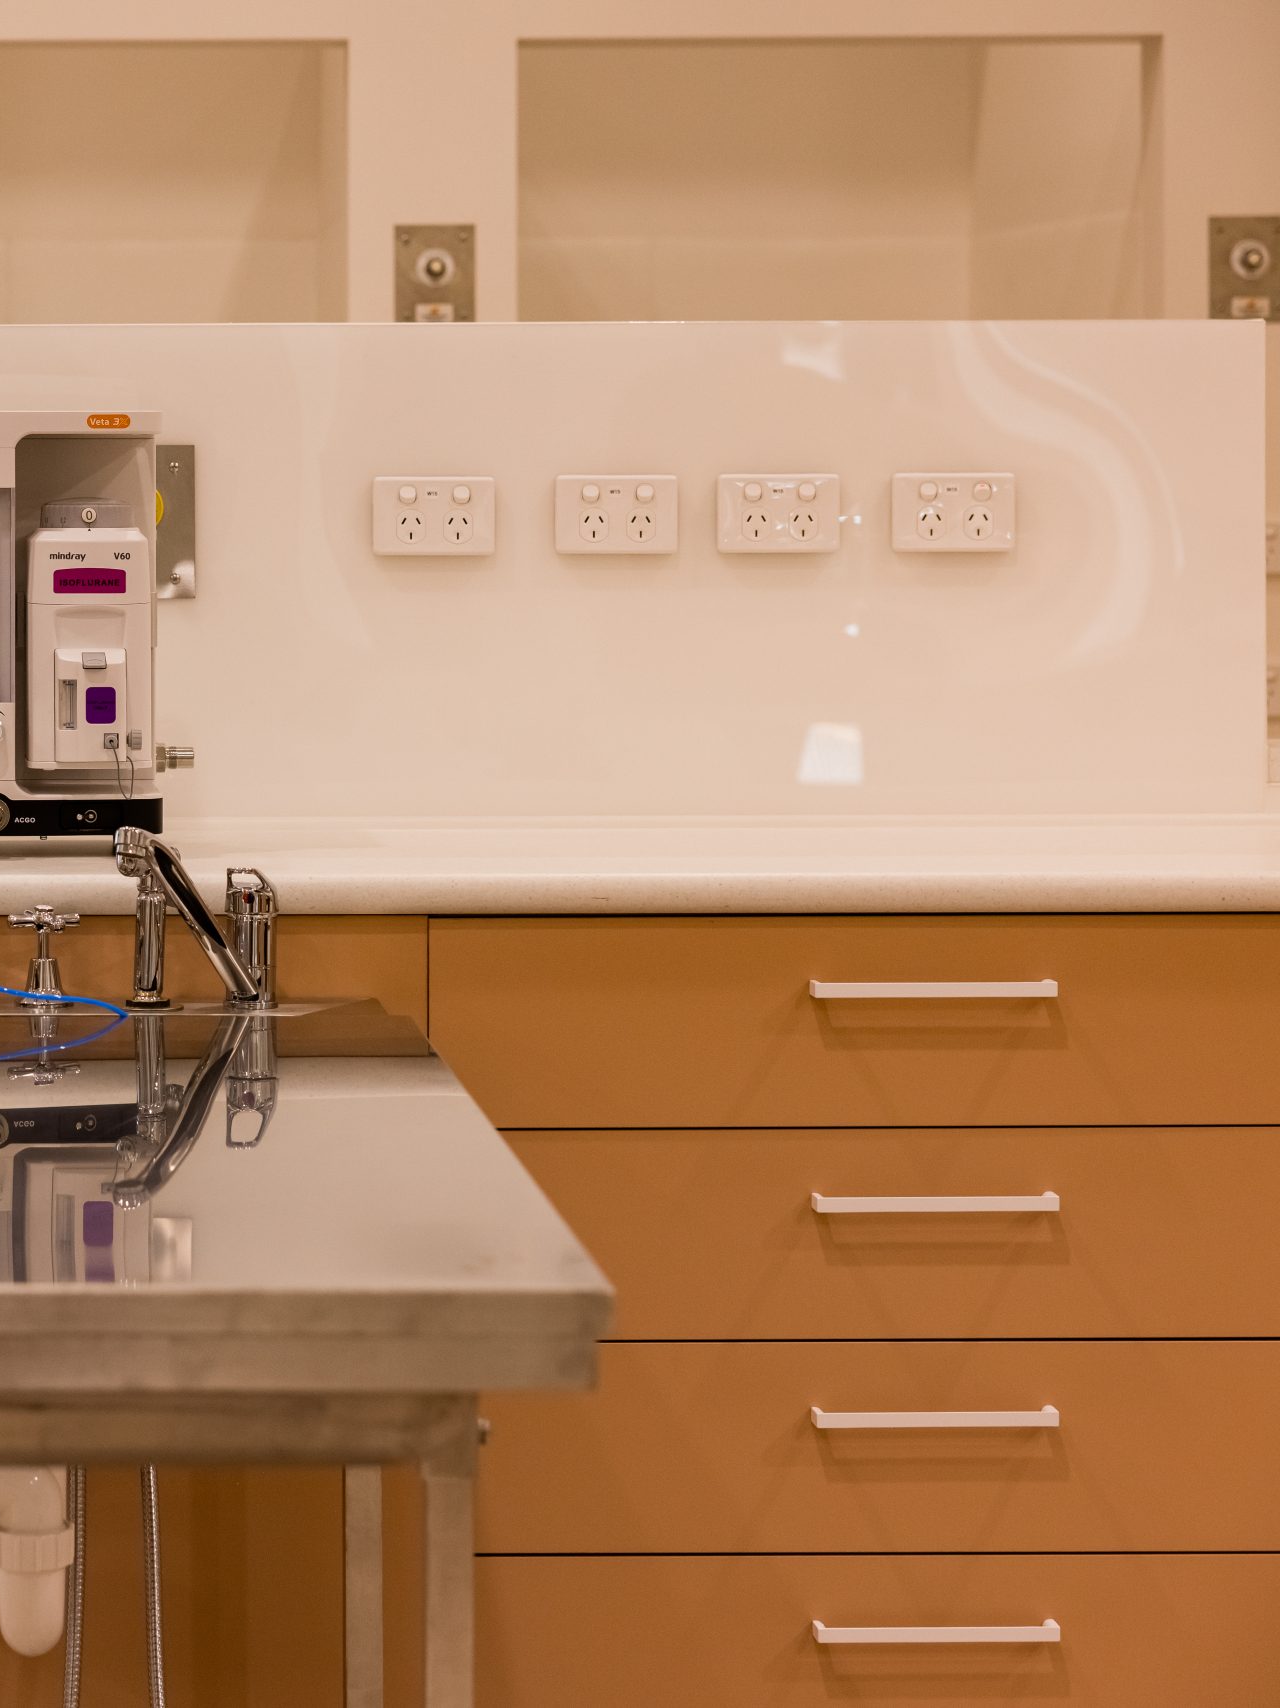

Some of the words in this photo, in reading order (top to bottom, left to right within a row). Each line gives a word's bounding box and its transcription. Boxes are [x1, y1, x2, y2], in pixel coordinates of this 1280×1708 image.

[90, 417, 110, 426] Veta
[85, 510, 93, 521] 0
[49, 552, 86, 562] mindray
[113, 552, 131, 560] V60
[60, 579, 120, 587] ISOFLURANE
